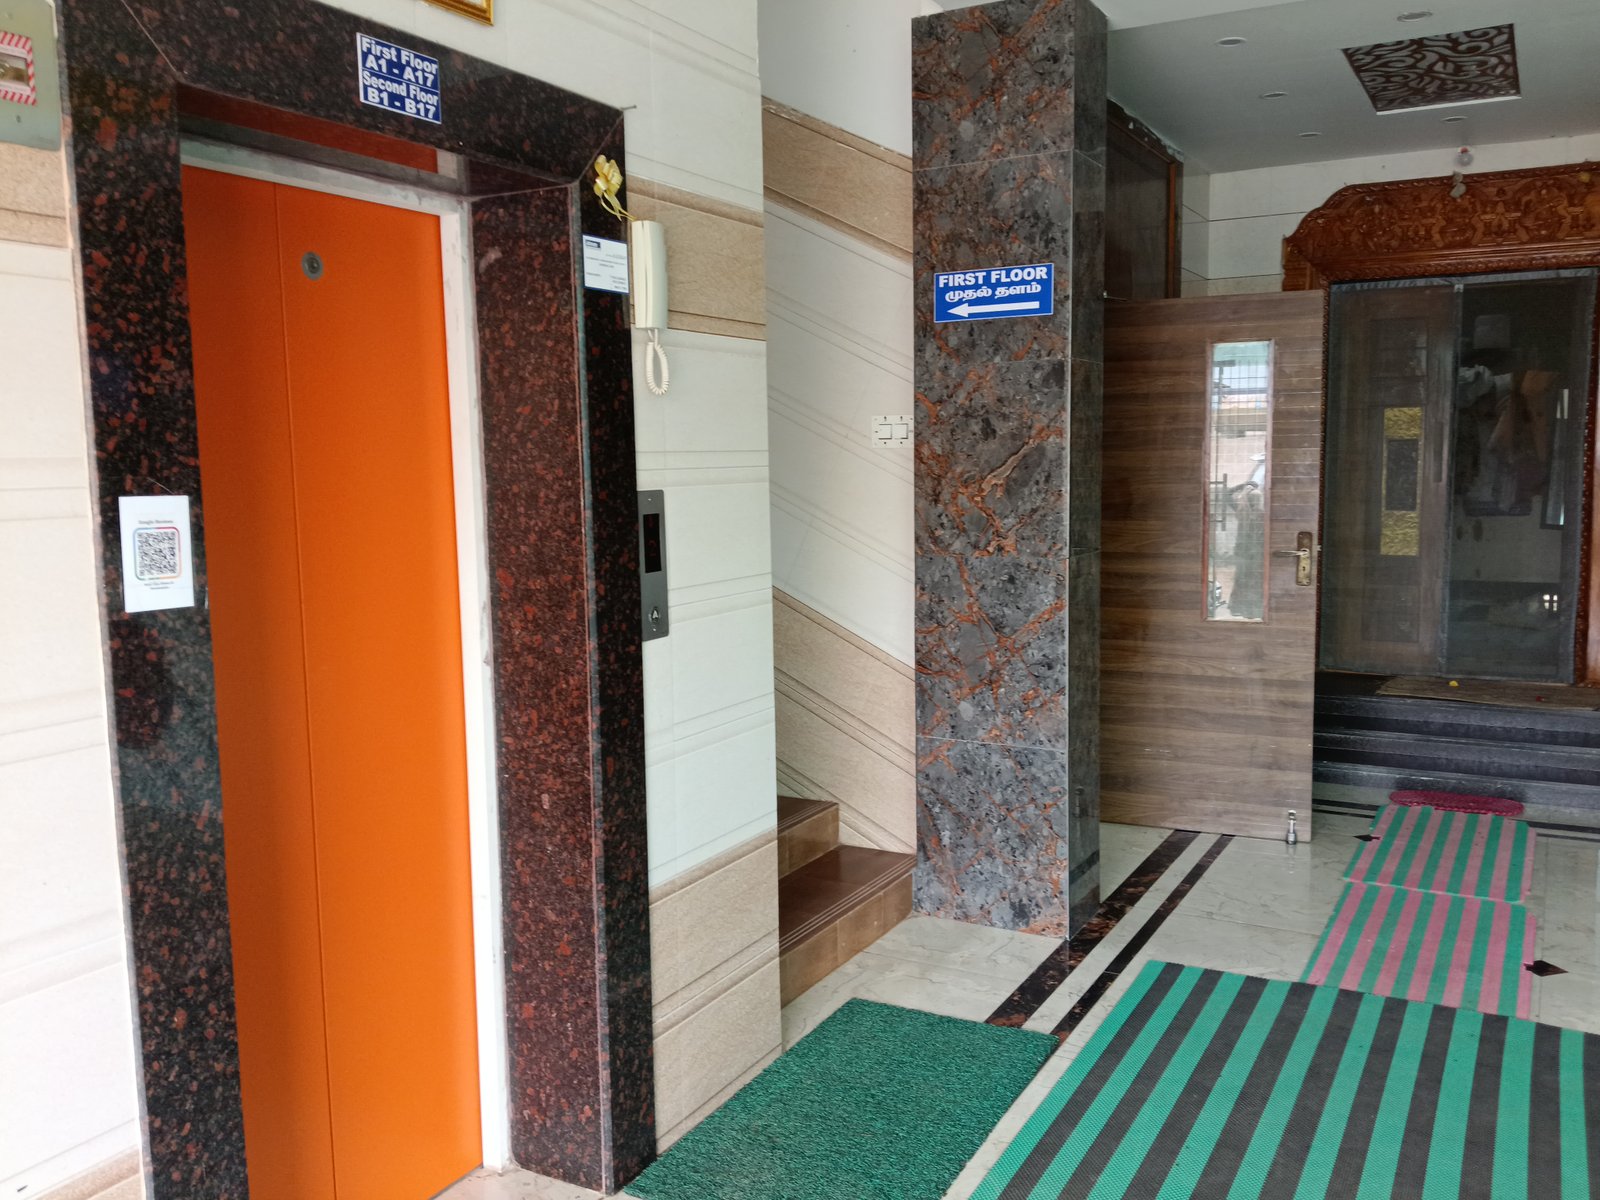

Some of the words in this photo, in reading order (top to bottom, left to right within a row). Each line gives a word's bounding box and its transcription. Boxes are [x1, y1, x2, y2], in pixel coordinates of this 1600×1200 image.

[361, 37, 397, 62] First
[401, 49, 438, 74] Floor
[365, 54, 387, 73] A1
[403, 66, 434, 87] A17
[362, 70, 407, 97] Second
[409, 84, 438, 105] Floor
[367, 86, 388, 106] B1
[404, 98, 436, 119] B17
[939, 271, 986, 288] FIRST
[990, 267, 1048, 284] FLOOR
[945, 286, 992, 303] முதல்
[994, 281, 1042, 299] தளம்
